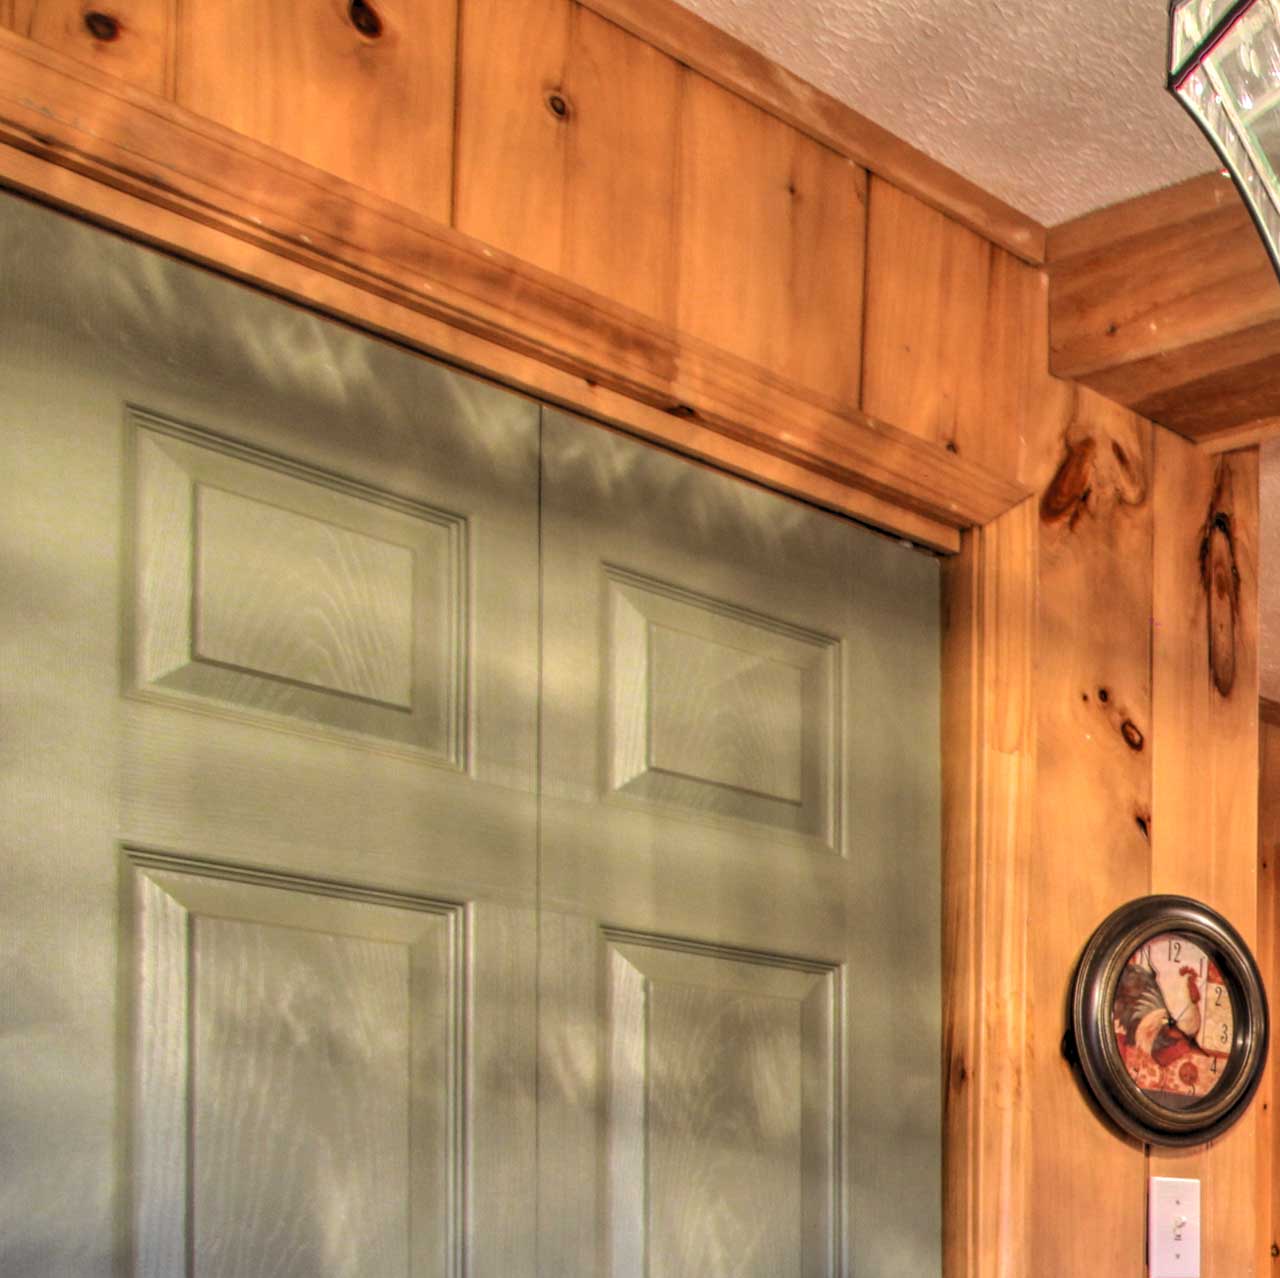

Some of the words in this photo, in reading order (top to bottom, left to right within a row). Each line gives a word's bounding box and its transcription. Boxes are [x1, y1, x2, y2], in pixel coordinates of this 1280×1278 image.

[1168, 940, 1182, 963] 12
[1215, 986, 1223, 1007] 2
[1220, 1023, 1229, 1045] 3
[1210, 1057, 1217, 1074] 4
